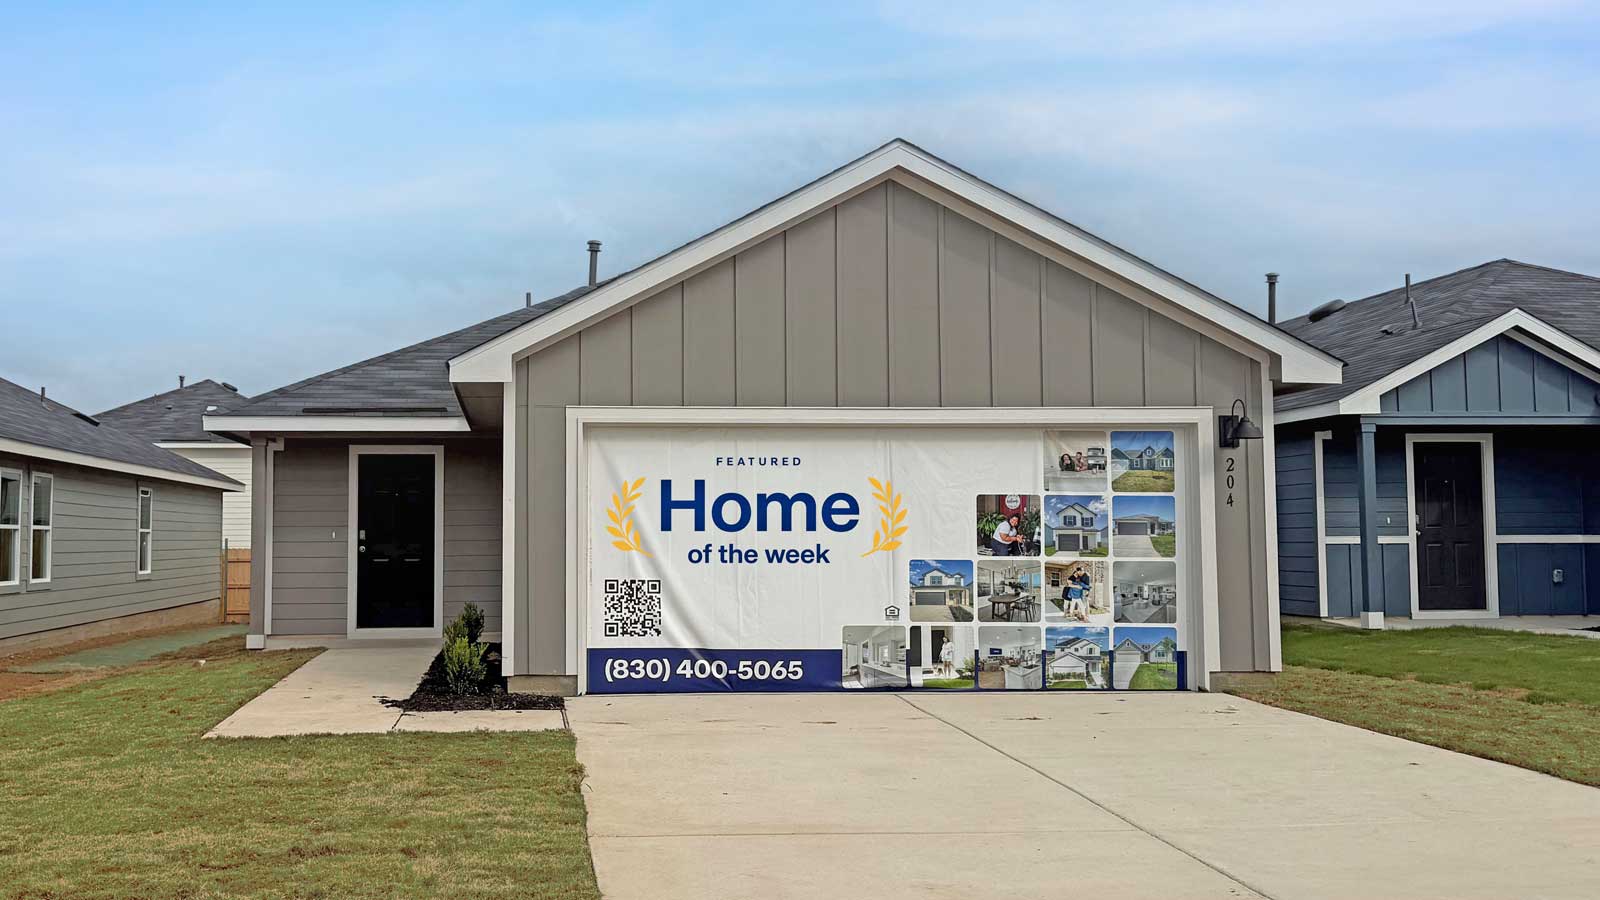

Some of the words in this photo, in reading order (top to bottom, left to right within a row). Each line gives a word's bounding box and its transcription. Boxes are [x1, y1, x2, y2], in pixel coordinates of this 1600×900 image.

[716, 457, 801, 466] FEATURED
[1226, 457, 1235, 507] 204
[660, 479, 860, 533] Home
[687, 544, 713, 564] of
[718, 544, 758, 564] the
[765, 544, 831, 564] week
[604, 658, 671, 682] (830)
[676, 659, 804, 680] 400-5065
